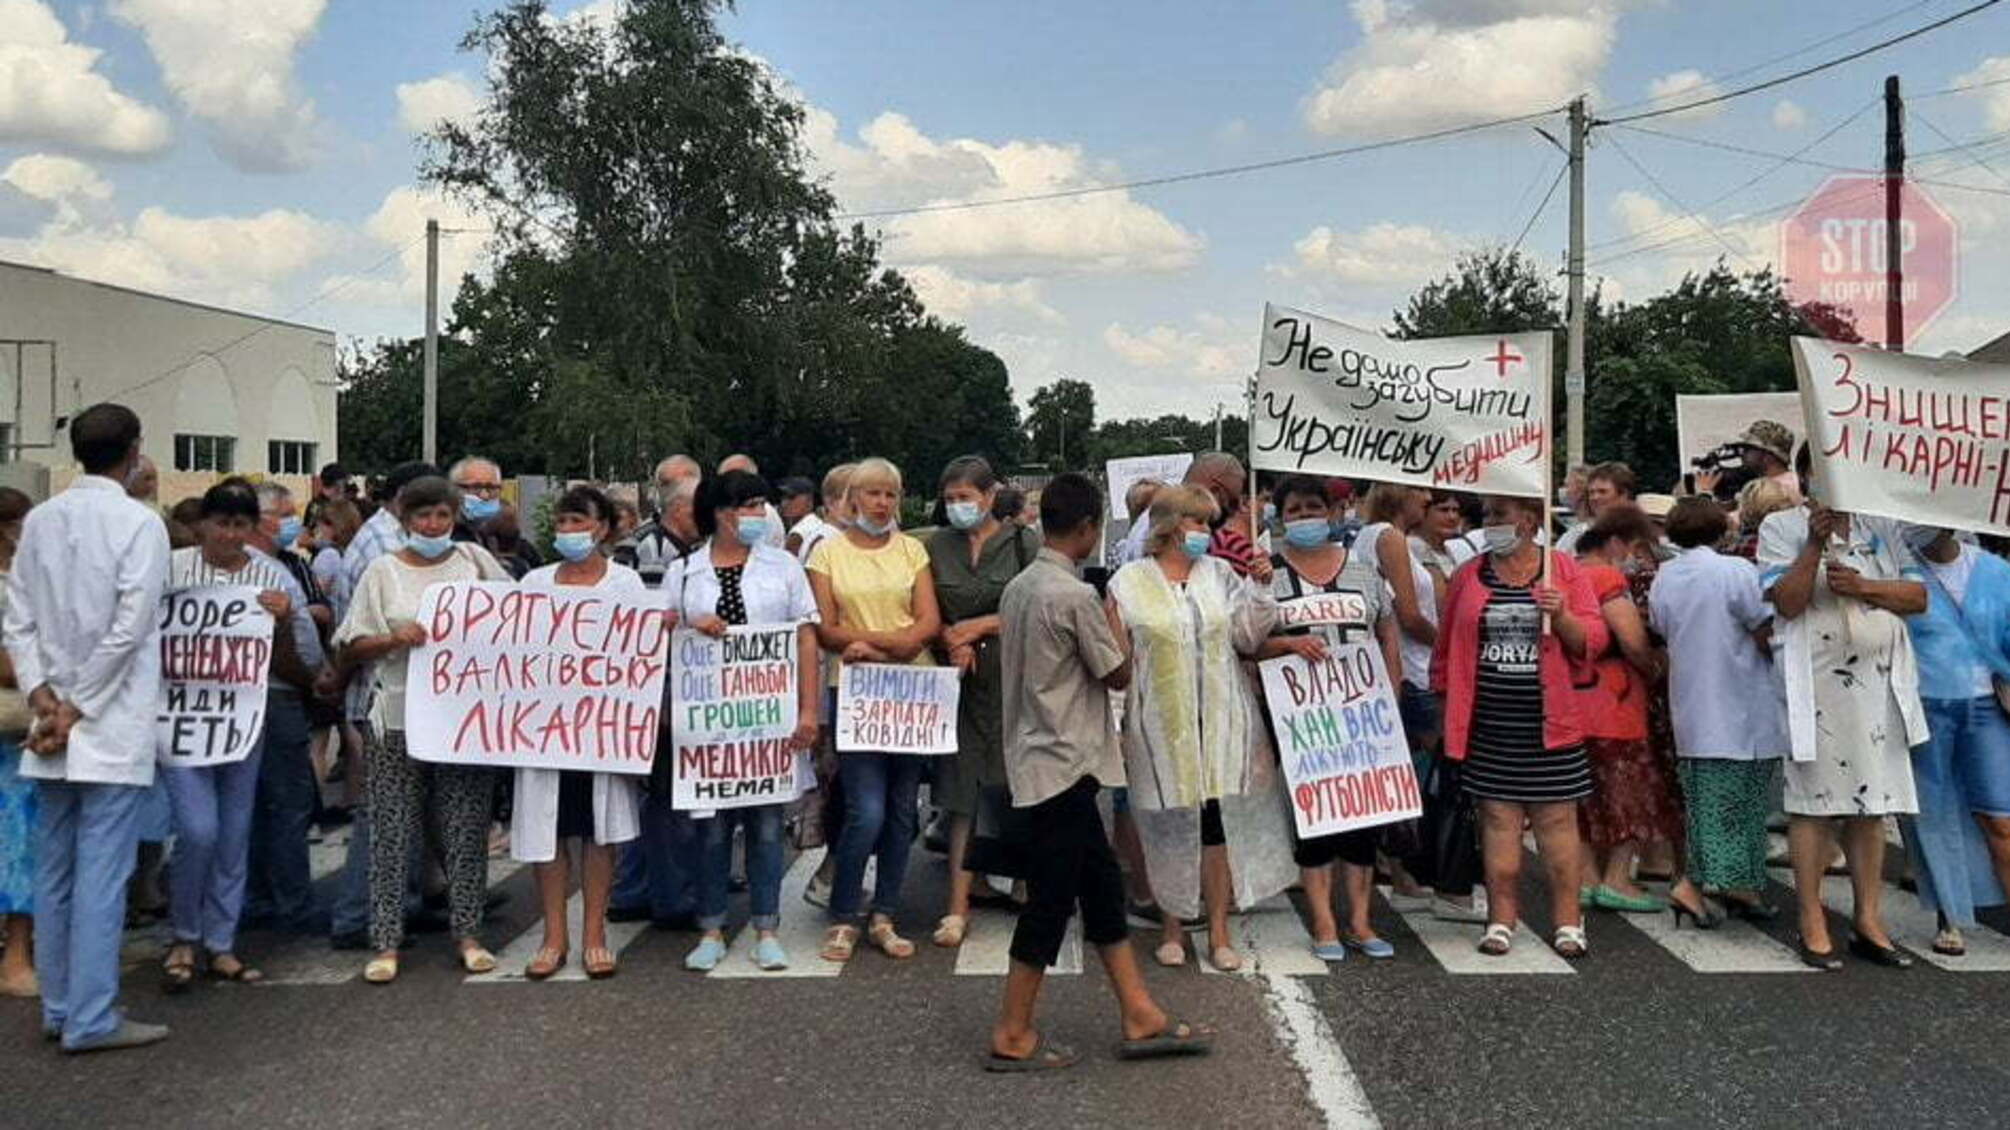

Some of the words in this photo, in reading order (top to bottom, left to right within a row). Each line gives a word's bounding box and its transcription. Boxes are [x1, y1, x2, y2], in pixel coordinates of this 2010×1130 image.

[1267, 318, 1333, 373] Не
[1257, 391, 1446, 474] Українську
[432, 585, 666, 658] ВРЯТУЄМО
[1282, 600, 1366, 626] PARIS
[433, 649, 663, 696] ВАЛКІВСЬКУ
[850, 666, 937, 700] ВИМОГИ
[454, 694, 657, 761] ЛІКАРНЮ
[1343, 699, 1394, 743] ВАС
[679, 735, 795, 781] МЕДИКІВ
[1295, 763, 1420, 827] ФУТБОЛІСТИ
